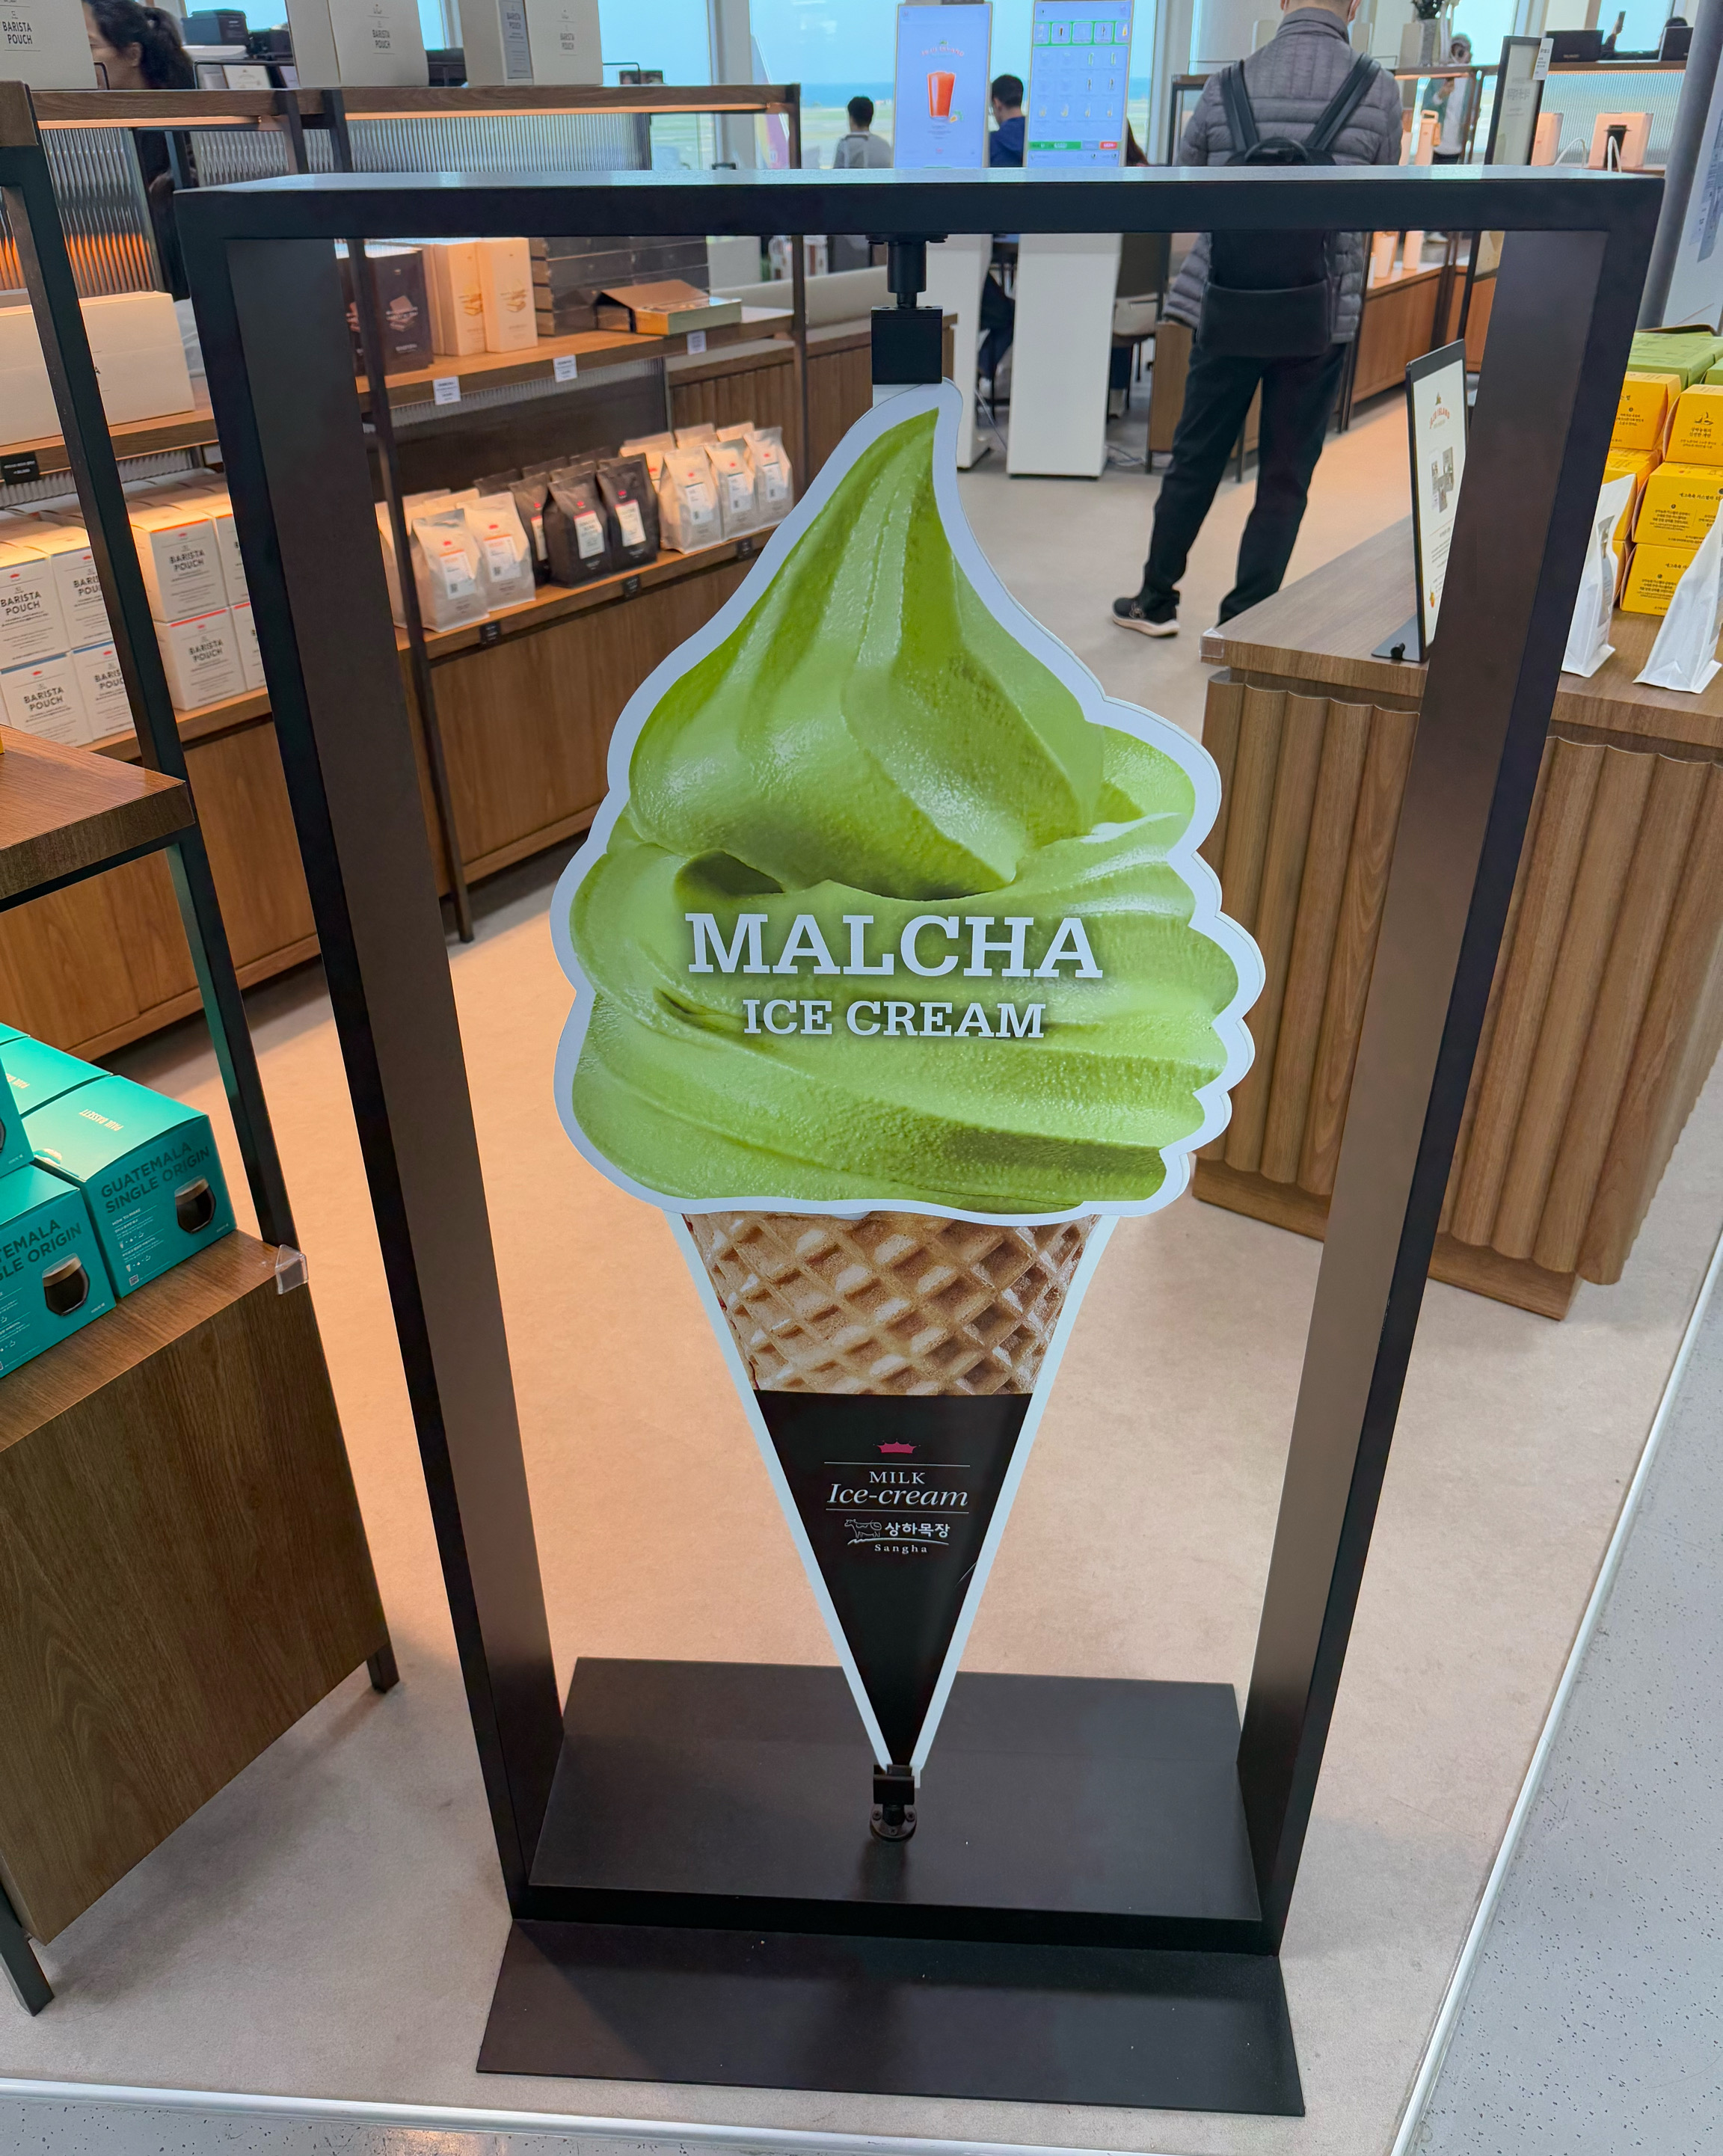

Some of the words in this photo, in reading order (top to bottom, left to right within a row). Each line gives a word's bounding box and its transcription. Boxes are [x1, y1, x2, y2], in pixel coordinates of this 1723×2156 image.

[2, 21, 32, 32] BARISTA
[7, 34, 33, 44] POUCH
[73, 575, 99, 589] BARI
[0, 591, 41, 607] BARISTA
[78, 586, 102, 597] POU
[5, 601, 41, 615] POUCH
[23, 686, 64, 704] BARISTA
[29, 695, 64, 711] POUCH
[685, 912, 1104, 979] MALCHA
[743, 998, 833, 1036] ICE
[846, 1000, 1046, 1038] CREAM
[79, 1108, 109, 1125] BASSETT
[104, 1120, 124, 1131] PAUL
[101, 1141, 192, 1198] GUATEMALA
[105, 1176, 159, 1213] SINGLE
[162, 1146, 210, 1182] ORIGIN
[28, 1223, 82, 1263] ORIGIN
[869, 1471, 925, 1484] MILK
[826, 1483, 968, 1506] Ice-cream
[885, 1522, 950, 1538] 상하목장
[874, 1544, 927, 1554] Sangha
